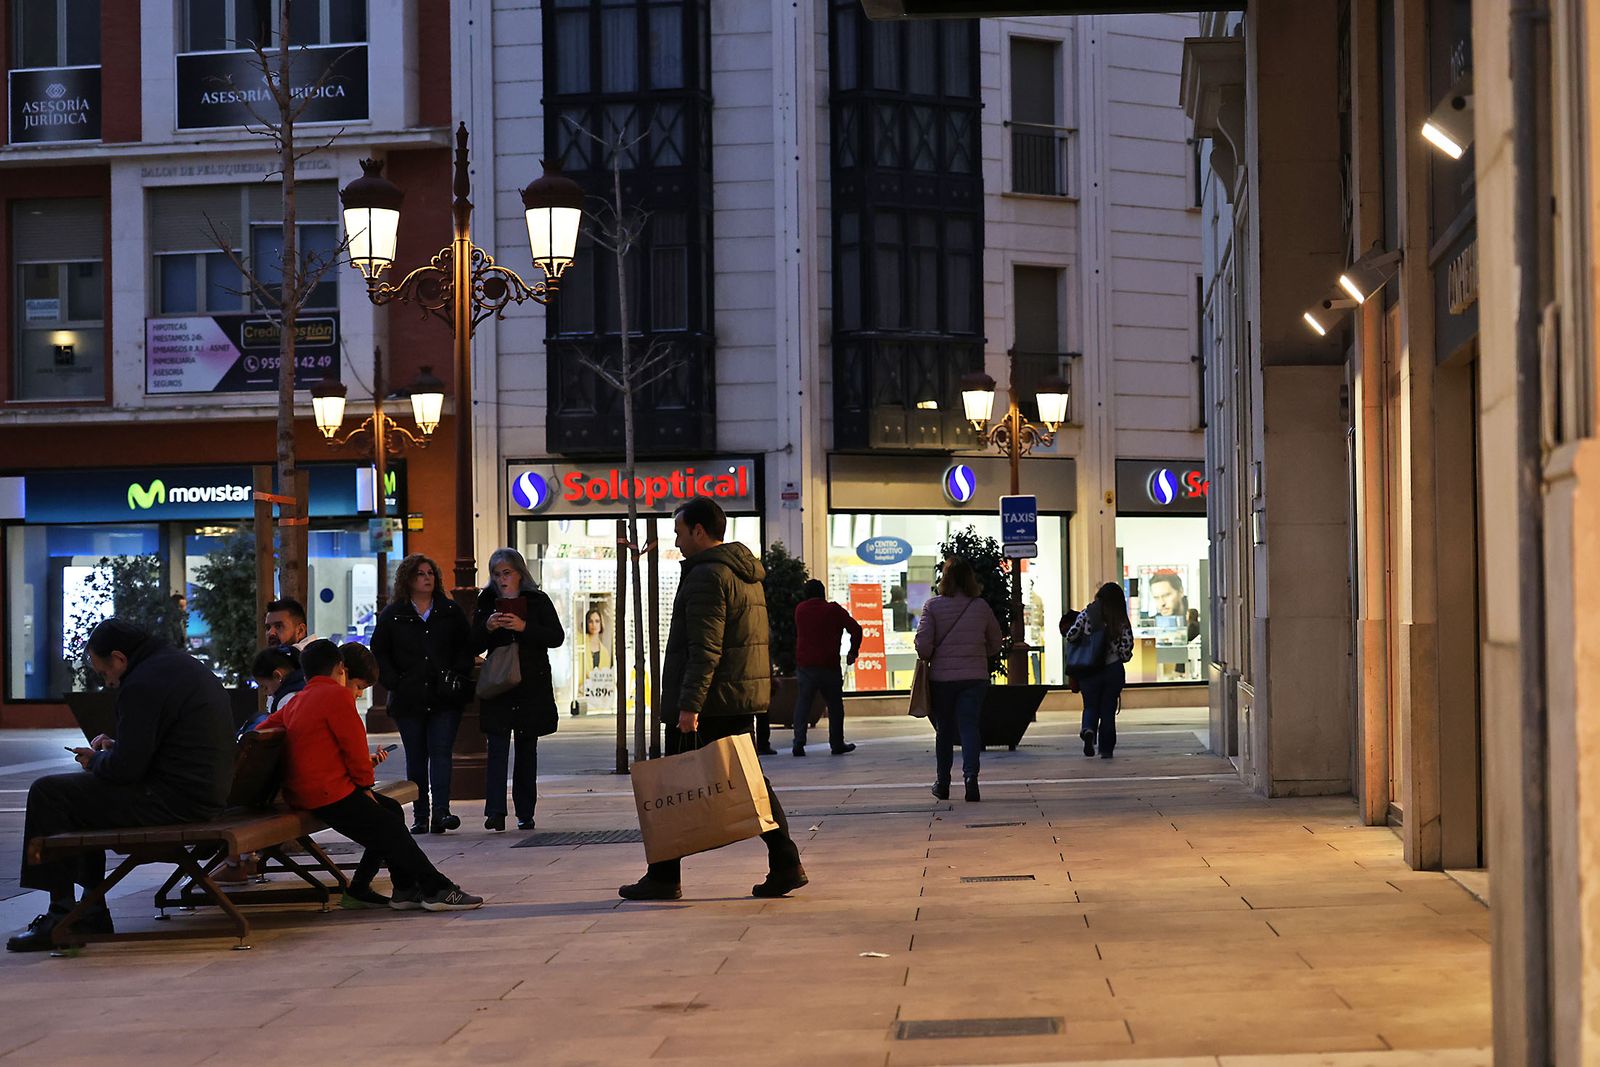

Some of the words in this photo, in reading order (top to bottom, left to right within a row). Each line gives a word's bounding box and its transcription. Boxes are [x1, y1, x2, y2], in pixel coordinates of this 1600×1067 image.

[201, 87, 271, 104] ASESORÍA
[22, 97, 89, 113] ASESORÍA
[24, 111, 87, 130] JURÍDICA
[180, 166, 195, 177] DE
[153, 322, 187, 331] HIPOTECAS
[153, 345, 188, 353] EMBARGOS
[261, 357, 281, 369] 959
[301, 356, 315, 368] 42
[317, 355, 332, 367] 49
[153, 380, 183, 388] SEGUROS
[169, 484, 252, 502] movistar
[563, 466, 747, 506] Soloptical
[1003, 513, 1036, 523] TAXIS
[875, 547, 903, 555] AUDITIVO
[643, 780, 736, 812] CORTEFIEL
